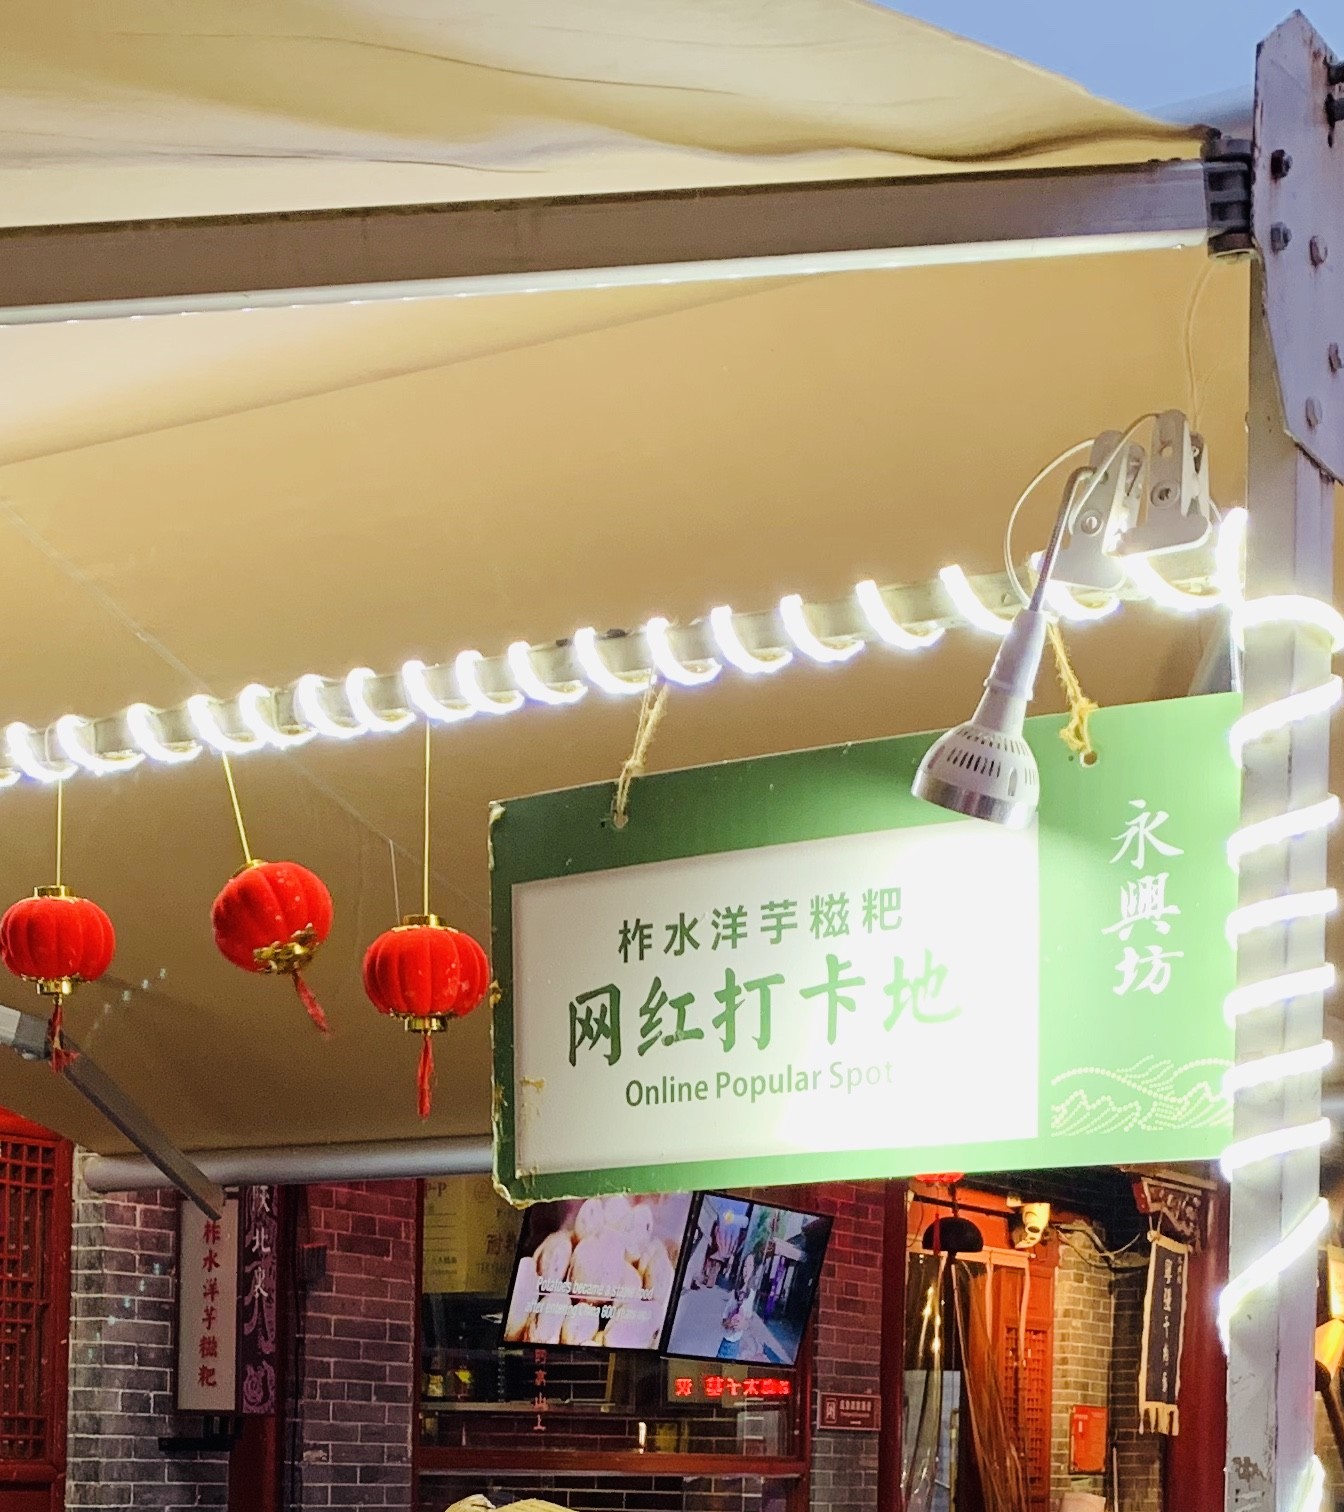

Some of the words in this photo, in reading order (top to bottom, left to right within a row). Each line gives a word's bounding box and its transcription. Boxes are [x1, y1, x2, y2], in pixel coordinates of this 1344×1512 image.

[618, 887, 903, 963] 柞水洋芋糍粑
[1101, 799, 1185, 996] 永興坊
[568, 948, 963, 1067] 网红打卡地
[625, 1076, 709, 1107] Online
[715, 1064, 823, 1103] Popular
[828, 1060, 894, 1091] Spot
[198, 1220, 221, 1387] 柞水洋芋糍粑
